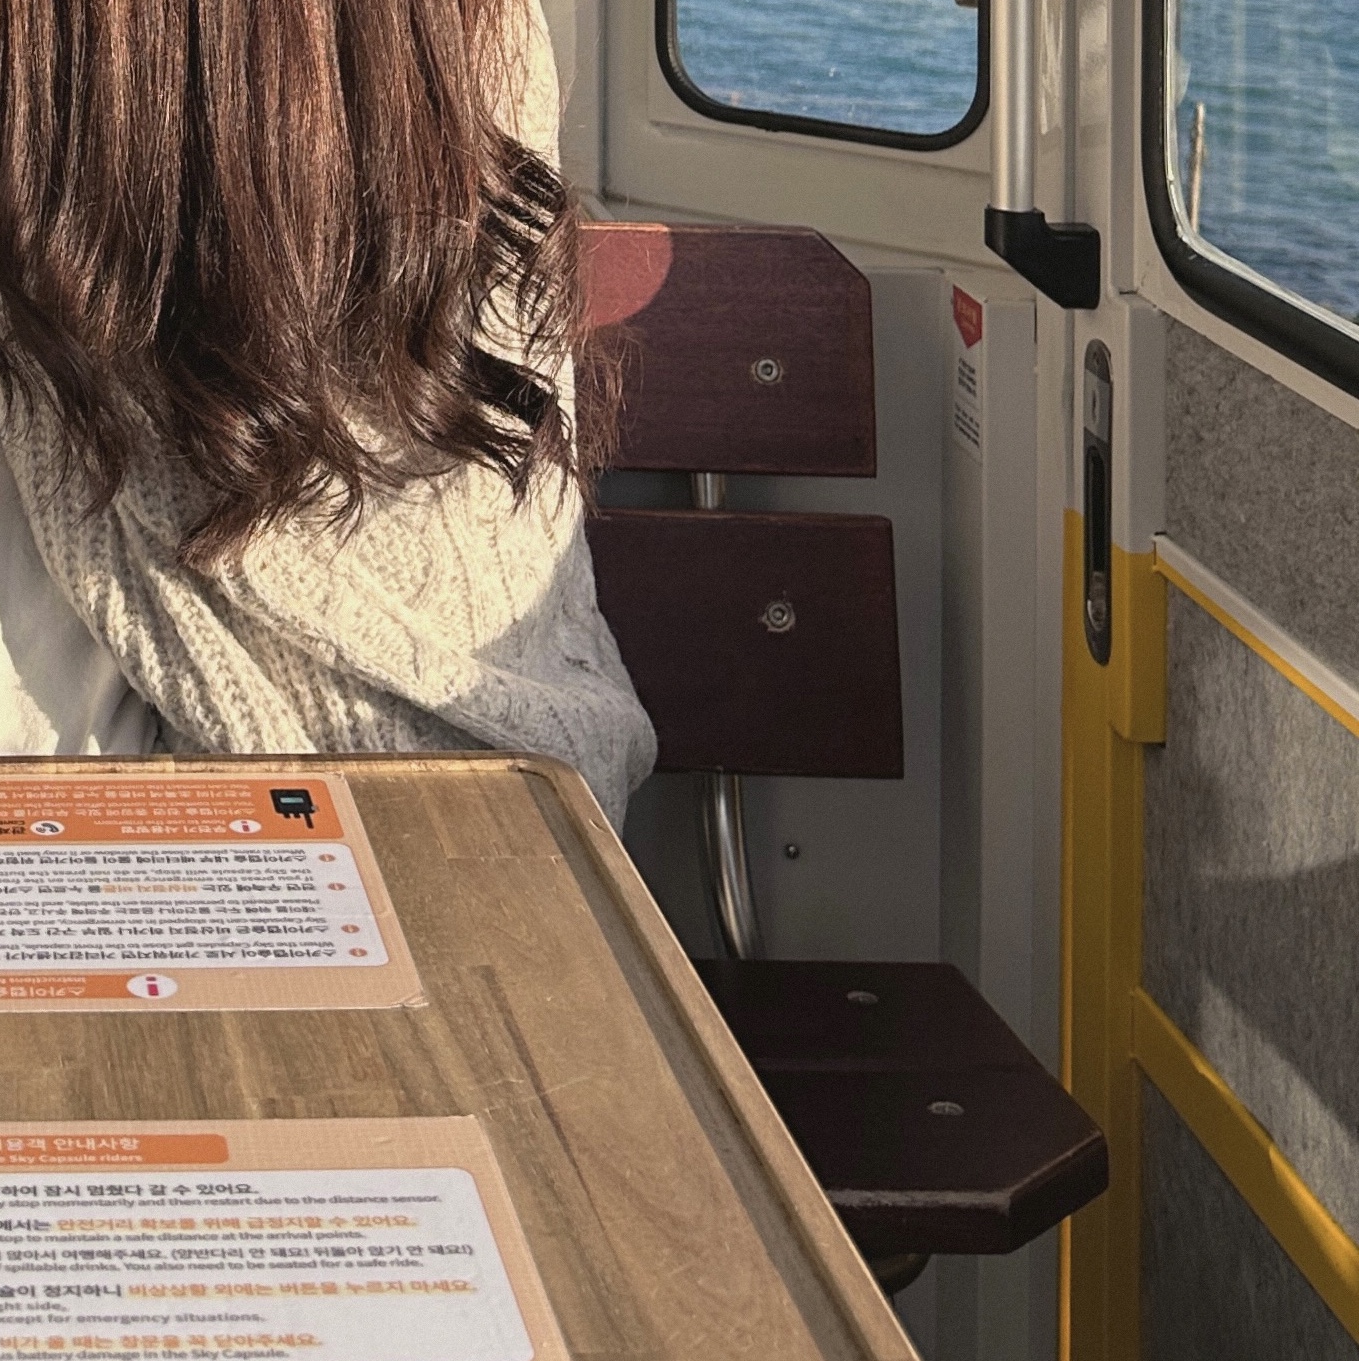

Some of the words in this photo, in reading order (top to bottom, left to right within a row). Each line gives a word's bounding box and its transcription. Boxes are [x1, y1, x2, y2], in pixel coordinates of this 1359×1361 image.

[53, 1138, 138, 1150] 안내사항
[8, 1155, 36, 1163] Sky
[38, 1155, 97, 1163] Capsule
[44, 1185, 80, 1197] 잠시
[86, 1184, 143, 1196] 멈췄다
[148, 1184, 167, 1196] 갈
[172, 1185, 191, 1195] 수
[57, 1219, 133, 1231] 안전거리
[140, 1218, 196, 1230] 확보를
[203, 1217, 240, 1229] 위해
[247, 1216, 322, 1229] 급정지할
[329, 1216, 346, 1227] 수
[43, 1285, 122, 1297] 정지하니
[128, 1284, 208, 1297] 비상상황
[214, 1283, 273, 1297] 외에는
[279, 1282, 338, 1295] 버튼을
[346, 1281, 405, 1294] 누르지
[46, 1314, 71, 1323] for
[75, 1315, 170, 1324] emergency
[0, 1336, 38, 1349] 비가
[46, 1336, 65, 1349] 올
[72, 1335, 112, 1349] 때는
[122, 1335, 180, 1349] 창문을
[188, 1334, 207, 1349] 꼭
